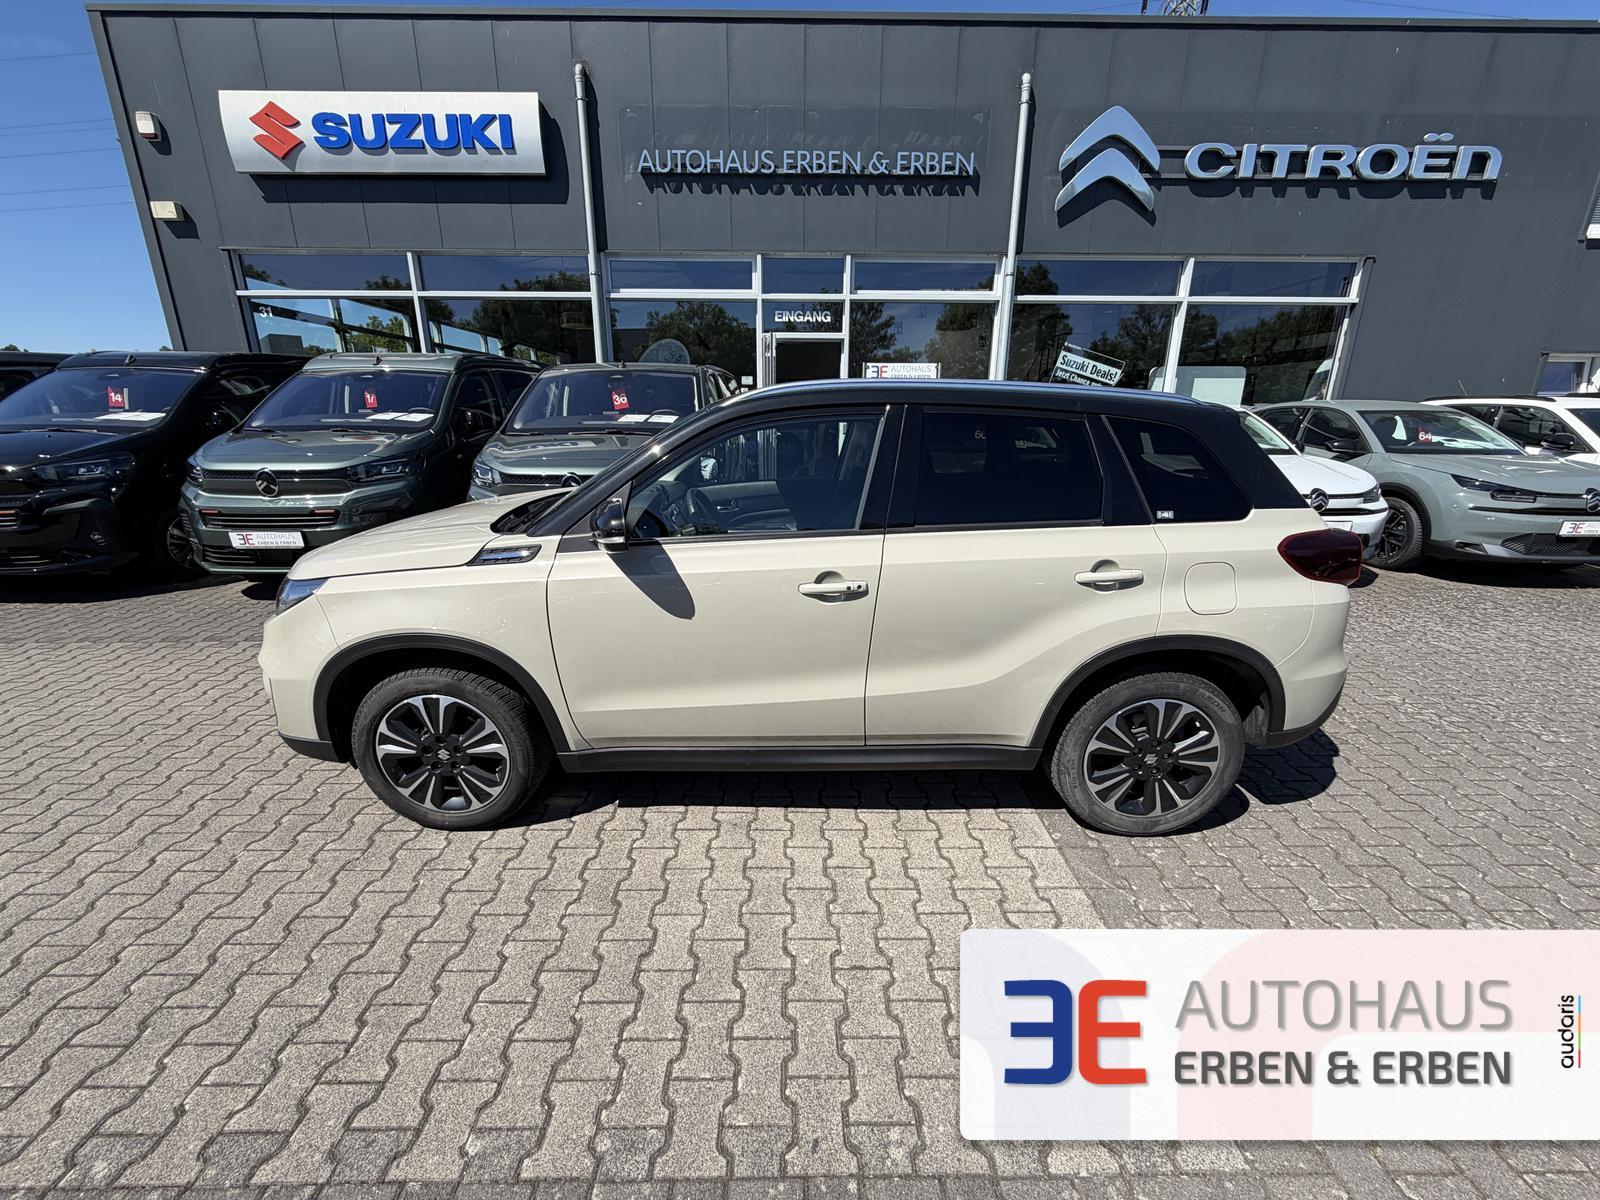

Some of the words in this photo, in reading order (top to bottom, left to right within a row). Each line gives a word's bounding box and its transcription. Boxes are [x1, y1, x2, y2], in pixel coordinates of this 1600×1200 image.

[311, 111, 514, 150] SUZUKI
[637, 149, 774, 174] AUTOHAUS
[783, 150, 861, 175] ERBEN
[868, 150, 890, 175] &
[896, 151, 975, 176] ERBEN
[258, 306, 273, 318] 31
[774, 310, 832, 323] EINGANG
[890, 365, 931, 373] AUTOHAUS
[1060, 354, 1091, 373] Suzuki
[1089, 364, 1118, 383] Deals!
[109, 391, 123, 403] 14
[612, 393, 628, 405] 36
[1418, 431, 1432, 441] 64
